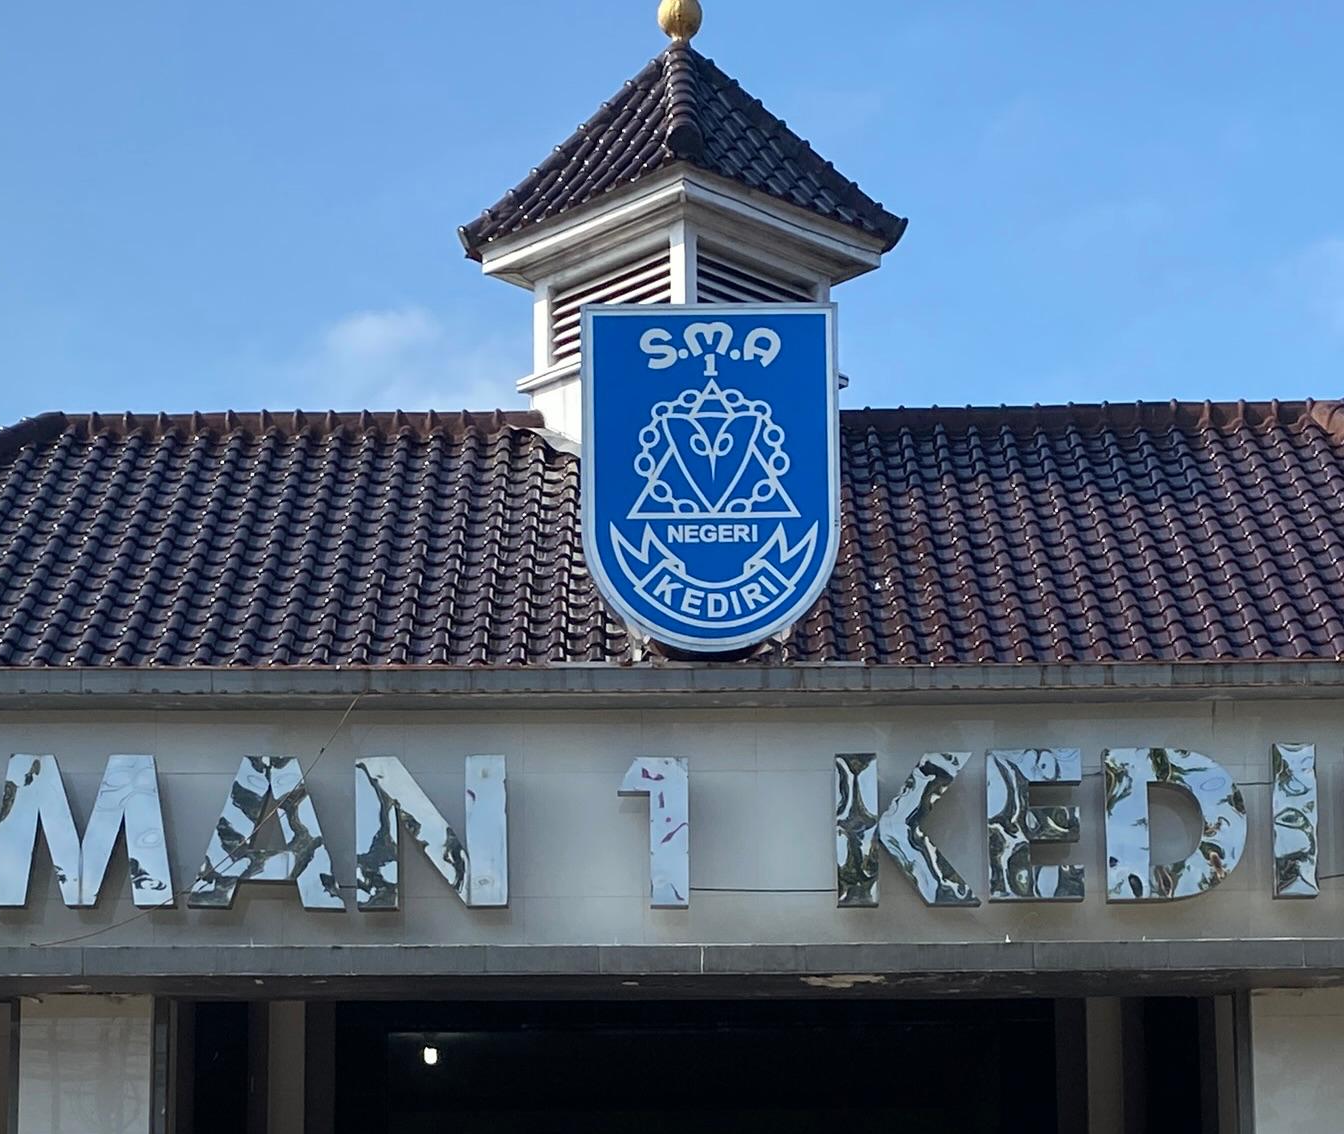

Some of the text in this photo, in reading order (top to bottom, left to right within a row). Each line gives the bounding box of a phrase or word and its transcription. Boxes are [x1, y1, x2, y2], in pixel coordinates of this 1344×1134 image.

[667, 524, 759, 544] NEGERI
[653, 575, 780, 618] KEDIRI
[617, 755, 691, 910] 1
